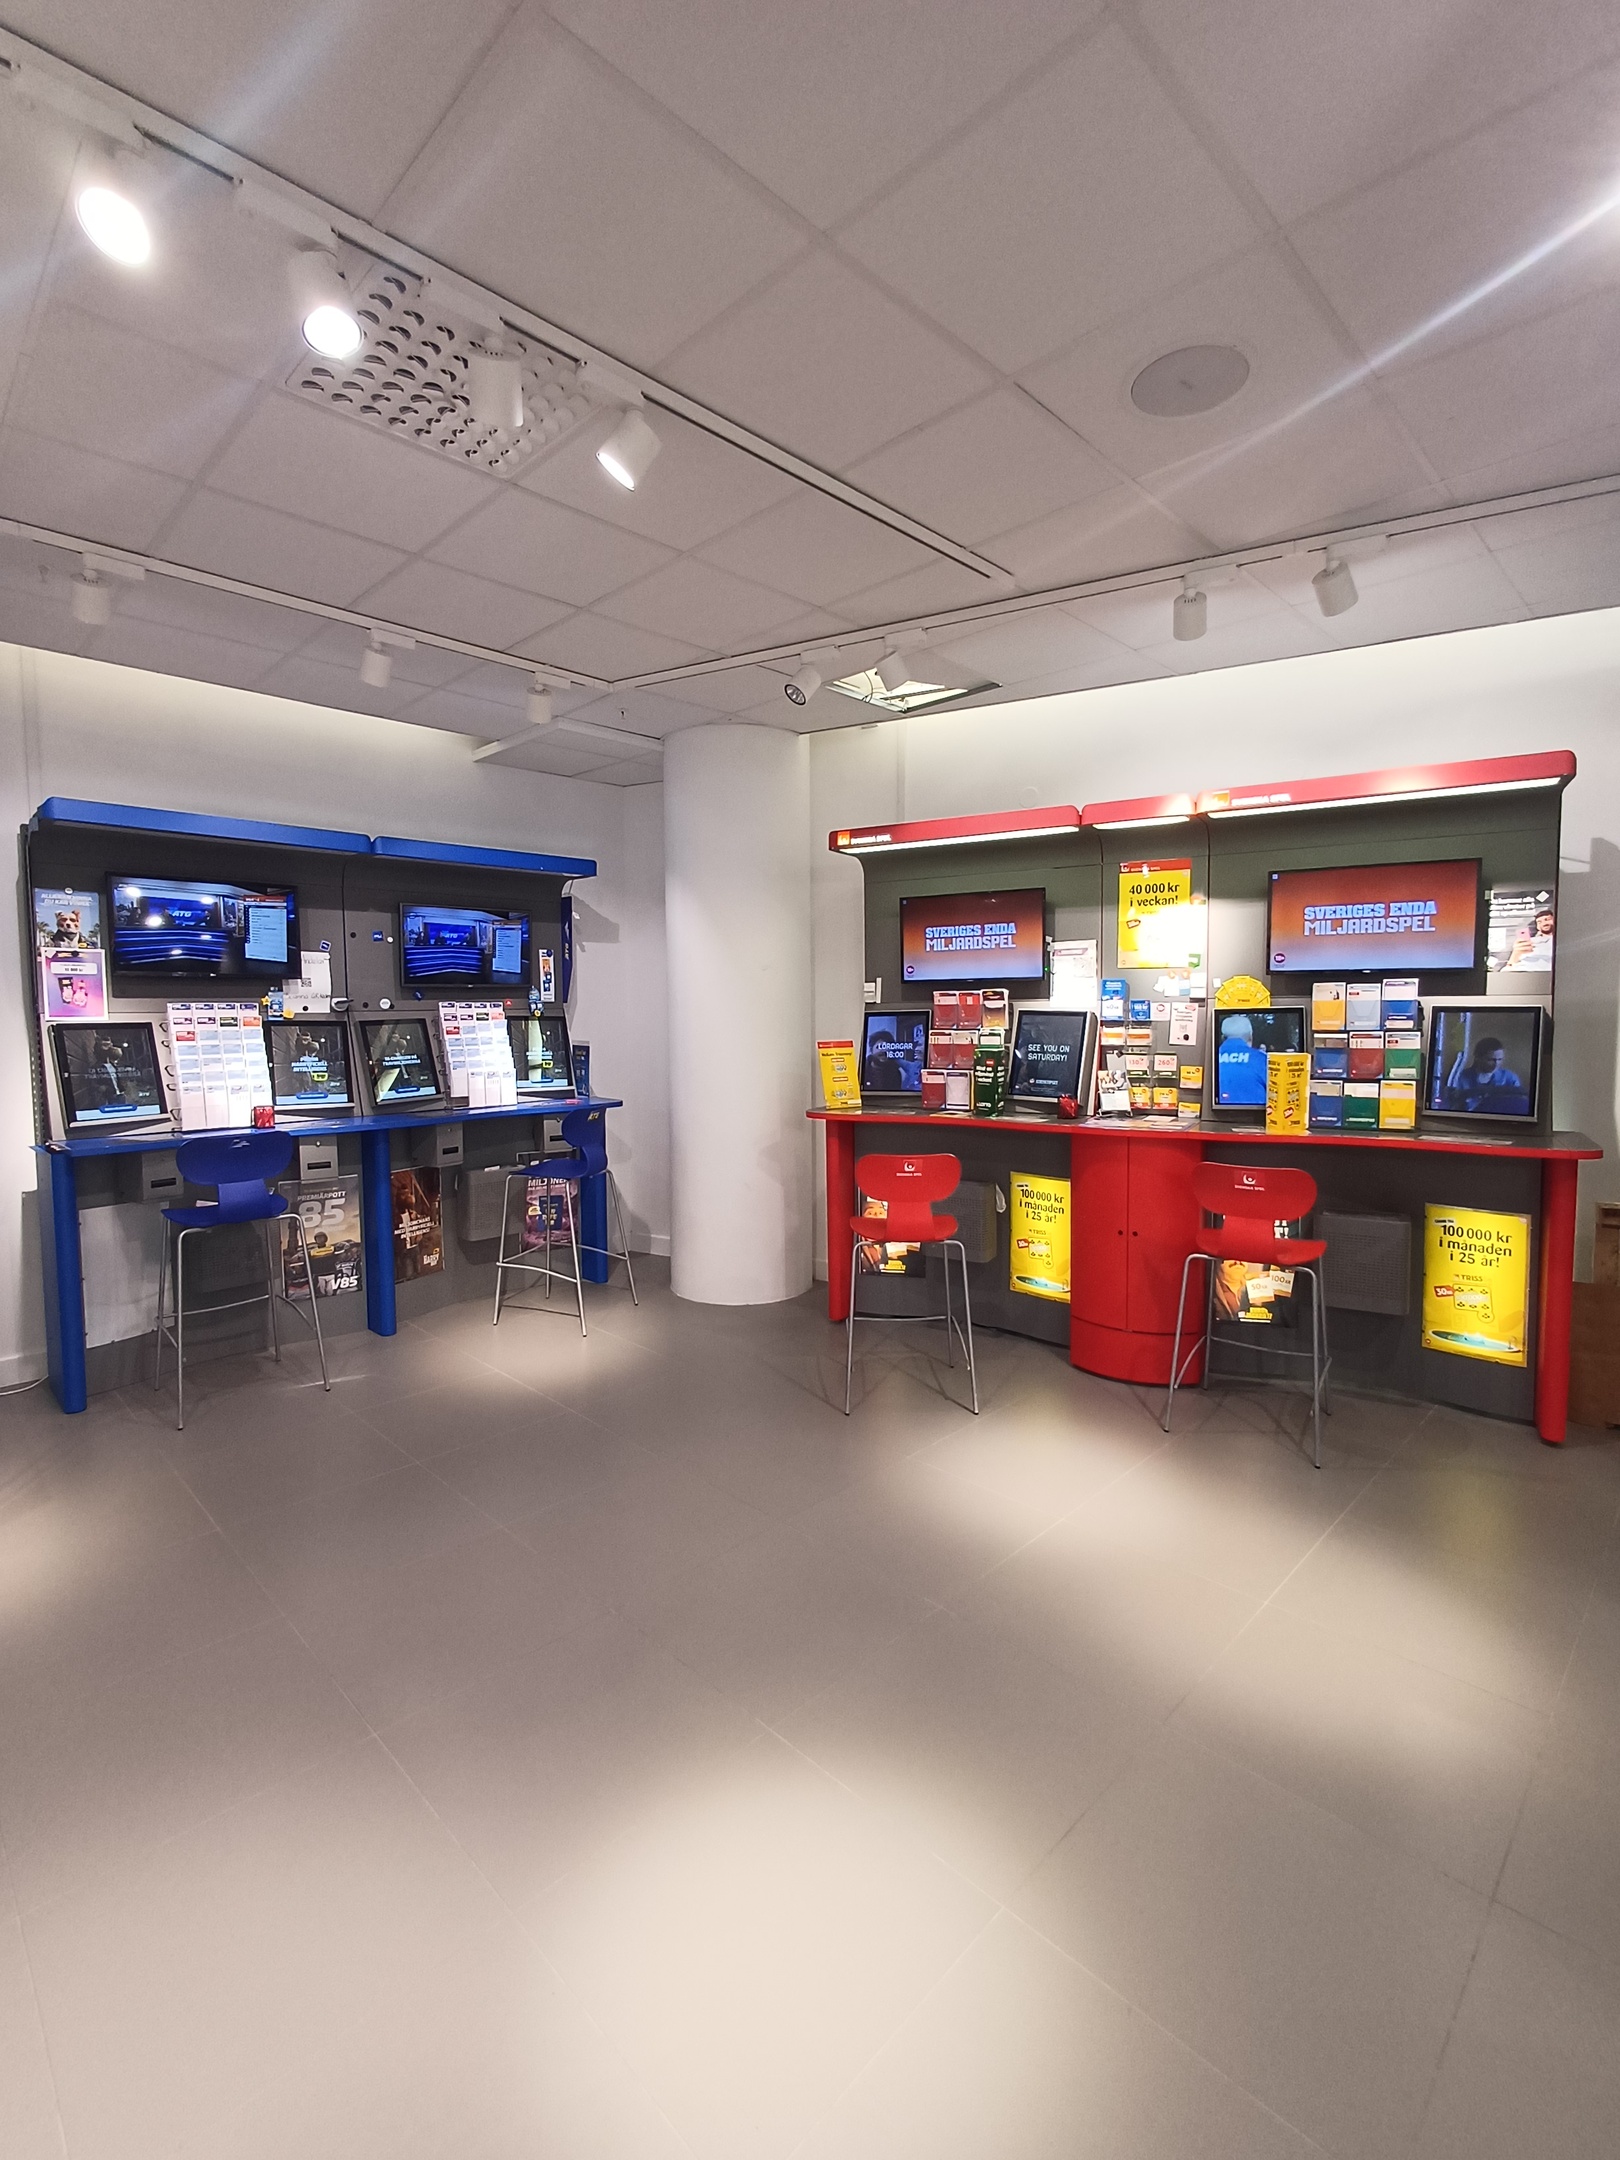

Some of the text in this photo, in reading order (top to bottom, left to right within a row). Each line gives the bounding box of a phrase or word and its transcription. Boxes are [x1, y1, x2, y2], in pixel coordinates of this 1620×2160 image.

[1129, 882, 1180, 894] 40 000 kr
[1137, 895, 1178, 907] veckan!
[1304, 900, 1437, 920] SVERIGES ENDA
[925, 922, 1017, 938] SVERIGES ENDA
[1304, 915, 1436, 936] MILJARDSPEL
[925, 935, 1017, 952] MILJARDSPEL
[878, 1042, 913, 1050] LÖRDAGAR
[1028, 1044, 1070, 1053] SEE YOU ON
[1027, 1053, 1068, 1062] SATURDAY!
[1219, 1053, 1249, 1063] ACH
[297, 1191, 346, 1201] PREMIÄRPOTT
[1021, 1189, 1065, 1203] 100 000 kr
[298, 1198, 346, 1228] 85
[1024, 1201, 1065, 1214] månaden
[1032, 1211, 1042, 1221] 25
[1045, 1213, 1056, 1223] år!
[1442, 1225, 1512, 1243] 100 000 kr
[1447, 1239, 1512, 1257] månaden
[1460, 1252, 1475, 1264] 25
[1480, 1254, 1500, 1268] år!
[332, 1276, 359, 1290] V85
[1461, 1274, 1483, 1282] TRISS
